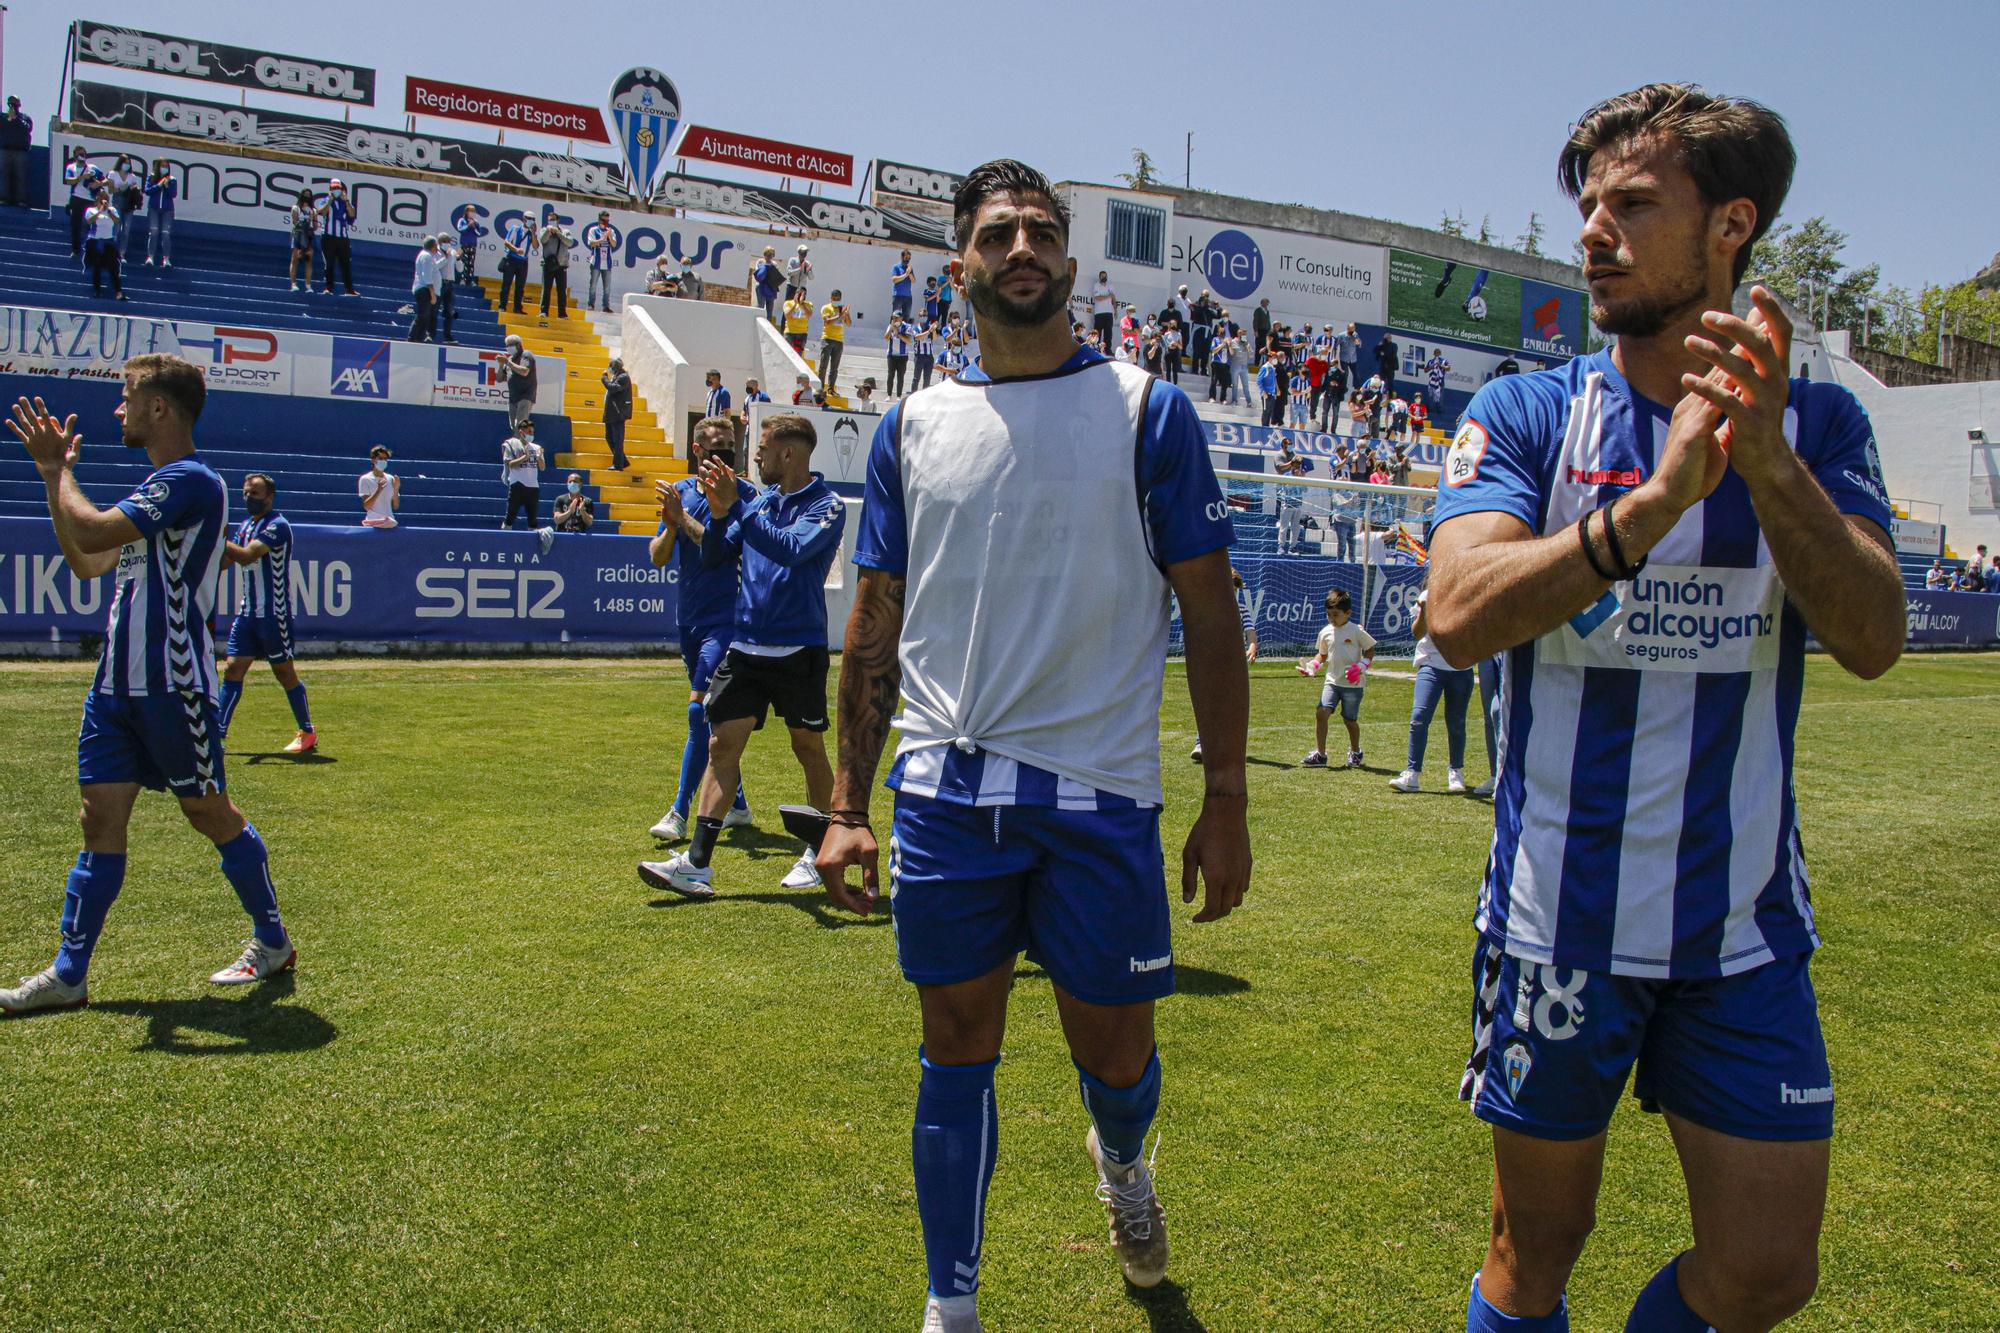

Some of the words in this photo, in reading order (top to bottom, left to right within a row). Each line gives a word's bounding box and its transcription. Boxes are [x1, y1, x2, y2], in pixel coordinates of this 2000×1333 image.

[89, 28, 210, 76] CEROL
[254, 56, 364, 99] CEROL
[153, 100, 268, 145] CEROL
[416, 87, 501, 117] Regidoria
[507, 103, 586, 132] d'Esports
[634, 105, 676, 118] ALCOYANO
[346, 128, 450, 170] CEROL
[700, 135, 792, 167] Ajuntament
[796, 152, 845, 178] d'Alcoi
[521, 155, 618, 193] CEROL
[881, 165, 955, 200] CEROL
[664, 177, 753, 216] CEROL
[368, 225, 393, 236] vida
[811, 202, 890, 238] CEROL
[1171, 235, 1257, 282] eknei
[1280, 255, 1292, 270] IT
[1296, 257, 1372, 286] Consulting
[1278, 278, 1372, 301] www.teknei.com
[28, 365, 59, 376] una
[225, 368, 280, 382] PORT
[331, 367, 379, 394] AXA
[433, 384, 471, 397] HITA
[489, 389, 509, 399] PO
[1567, 464, 1641, 486] hummel
[445, 550, 540, 564] CADENA
[0, 554, 102, 615] IKO
[415, 567, 565, 619] SER
[1632, 574, 1723, 606] unión
[594, 598, 634, 613] 1.485
[638, 599, 664, 613] OM
[1266, 596, 1314, 623] cash
[1627, 604, 1773, 649] alcoyana
[1929, 615, 1959, 631] ALCOY
[1625, 643, 1698, 662] seguros
